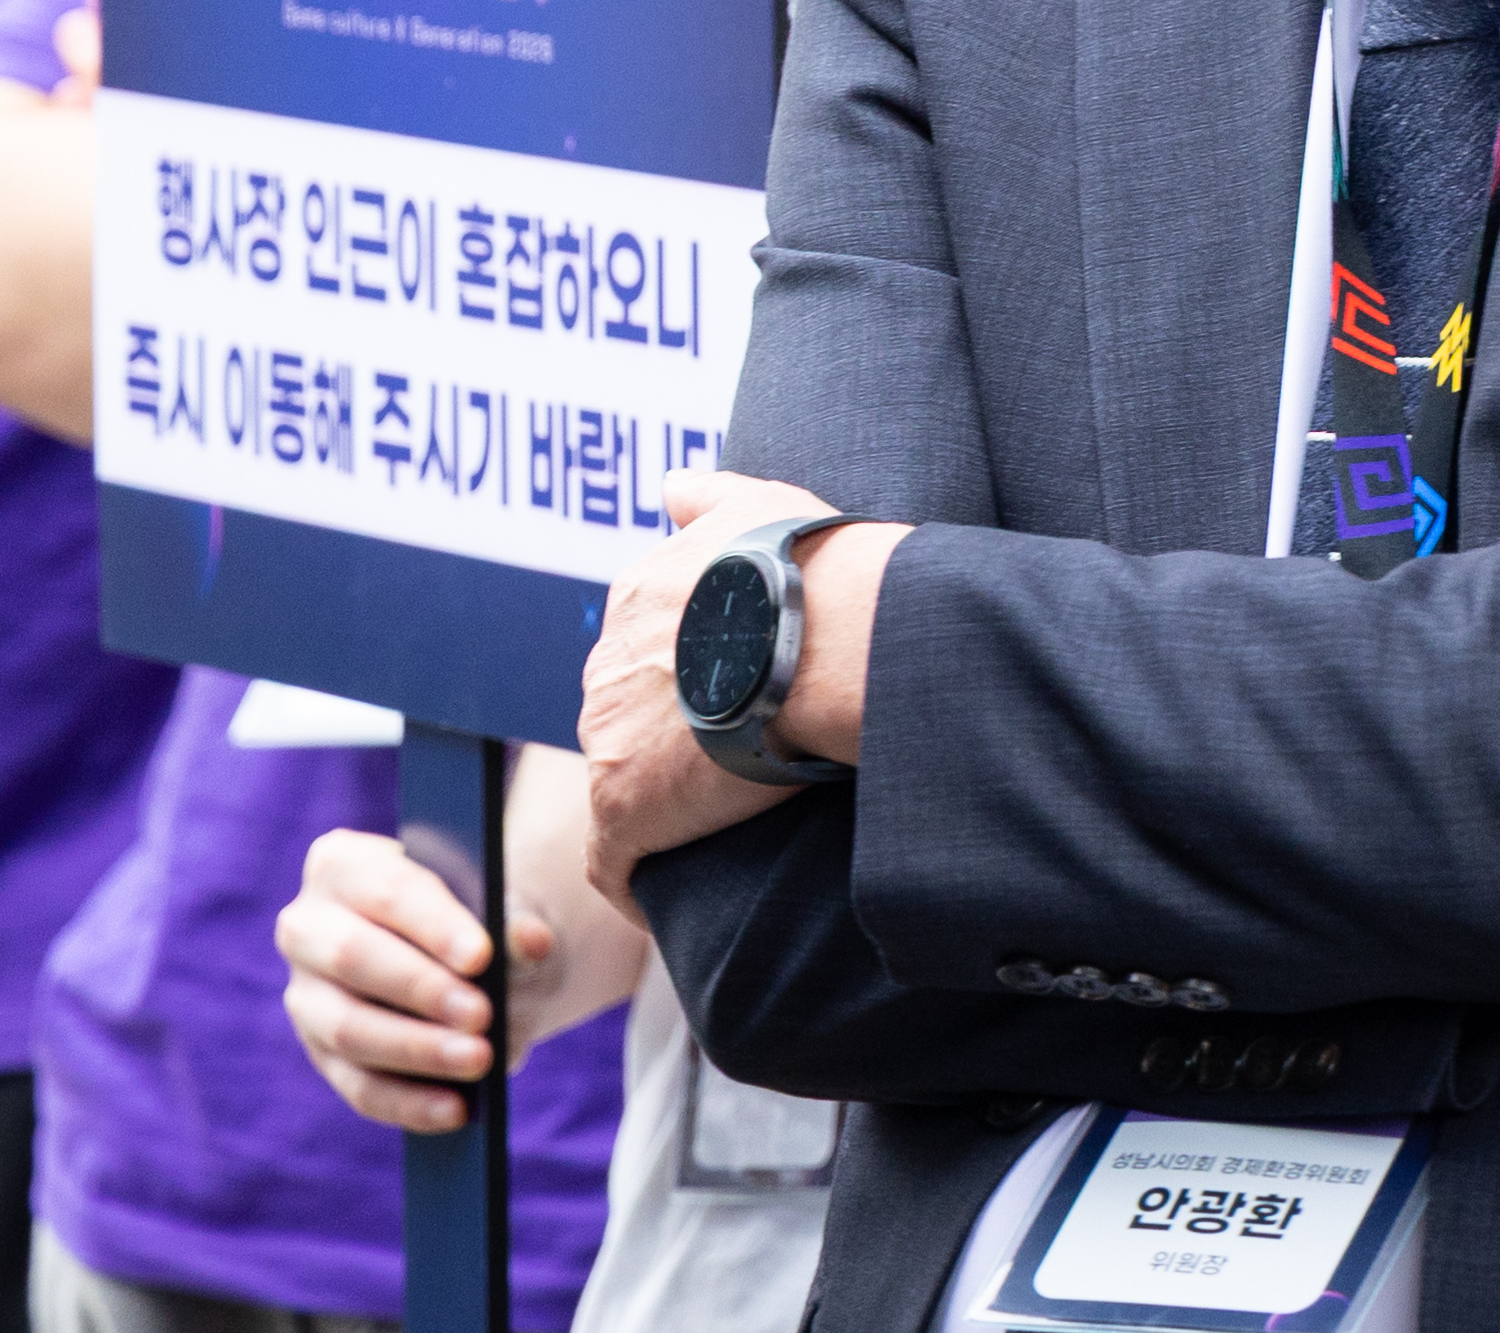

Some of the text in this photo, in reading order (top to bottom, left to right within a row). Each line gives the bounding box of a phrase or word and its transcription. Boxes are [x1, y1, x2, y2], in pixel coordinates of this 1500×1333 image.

[158, 153, 700, 358] 행사장 인근이 혼잡하오니
[126, 323, 206, 444] 즉시
[223, 346, 355, 475] 이동해
[373, 371, 509, 508] 주시기
[1111, 1151, 1372, 1185] 성남시의회 경제환경위원회
[1128, 1186, 1304, 1240] 안광환
[1149, 1250, 1229, 1276] 위원장
